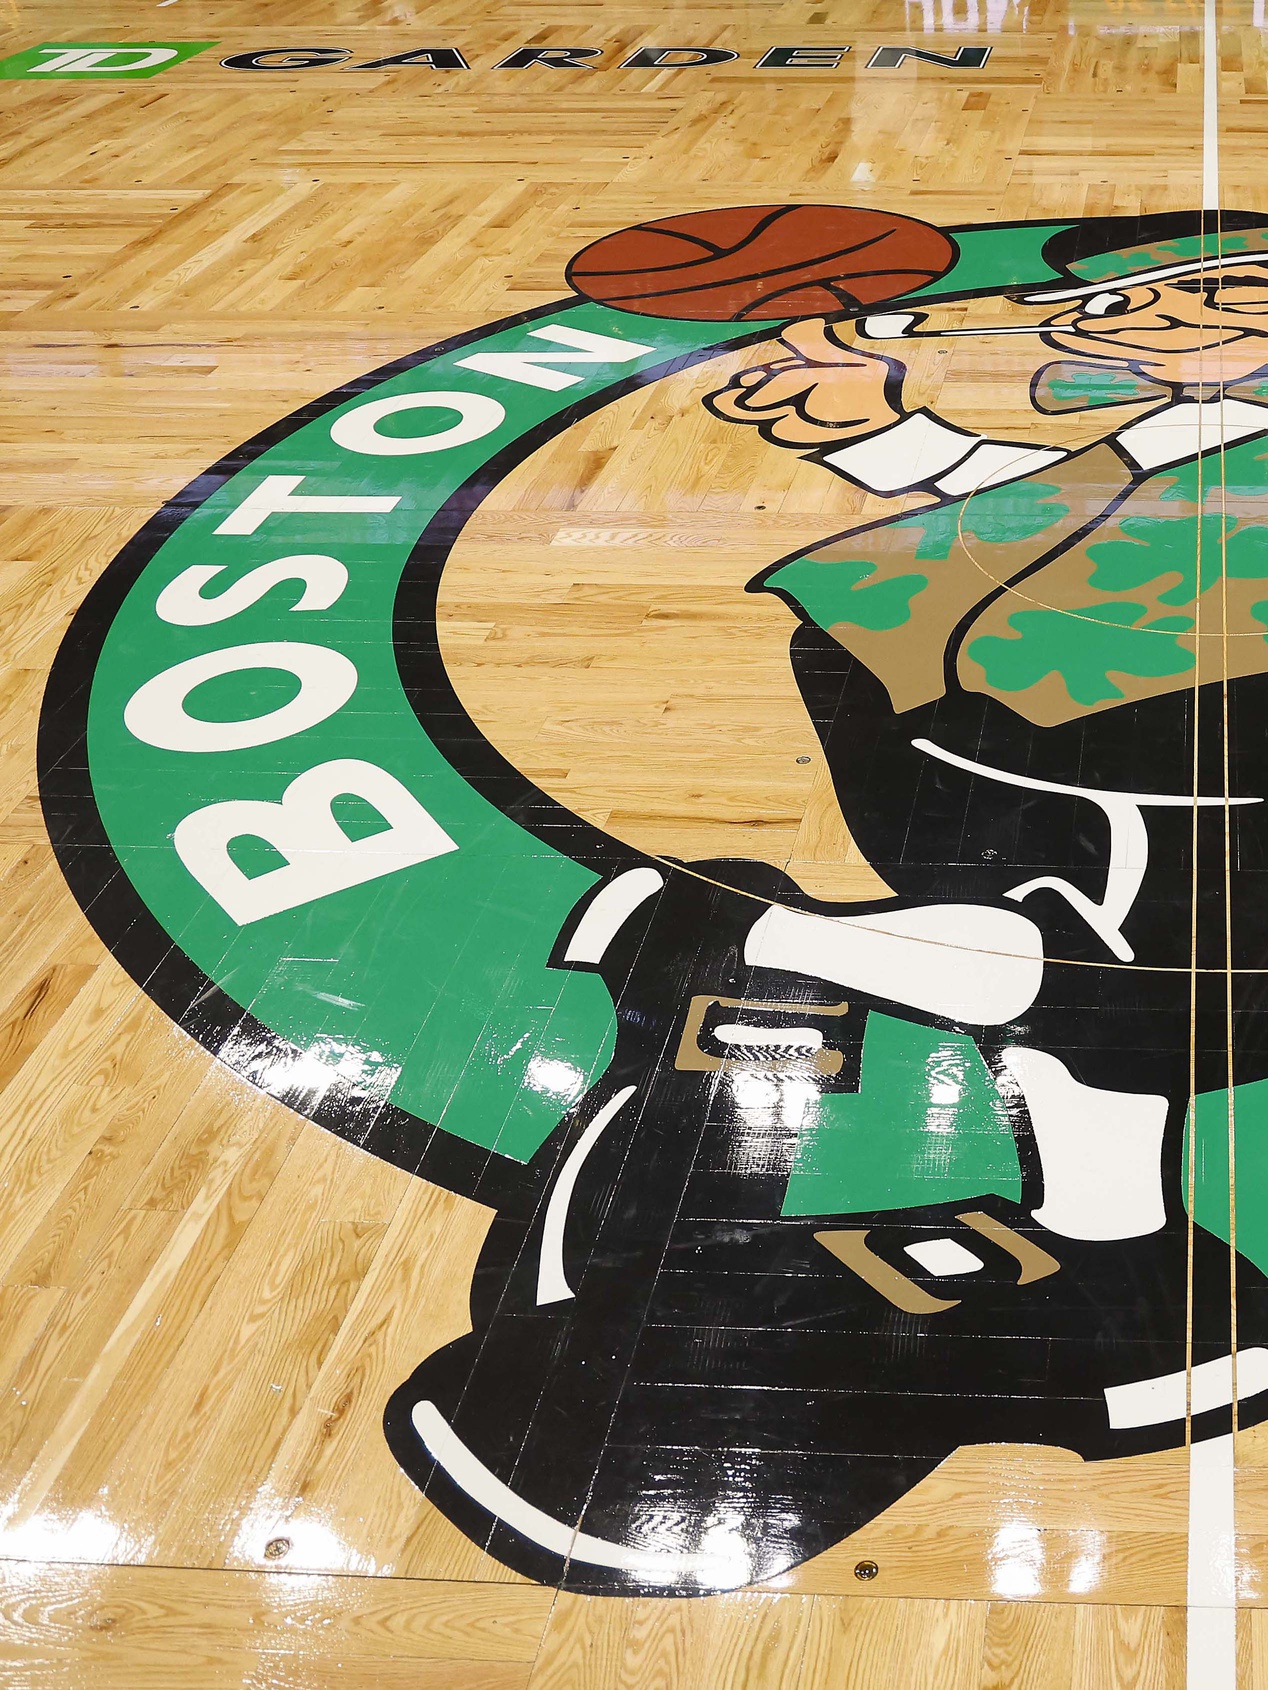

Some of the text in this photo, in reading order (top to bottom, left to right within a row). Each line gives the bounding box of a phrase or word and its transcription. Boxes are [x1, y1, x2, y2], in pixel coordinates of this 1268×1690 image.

[26, 46, 993, 72] TD GARDEN
[123, 324, 657, 927] BOSTON
